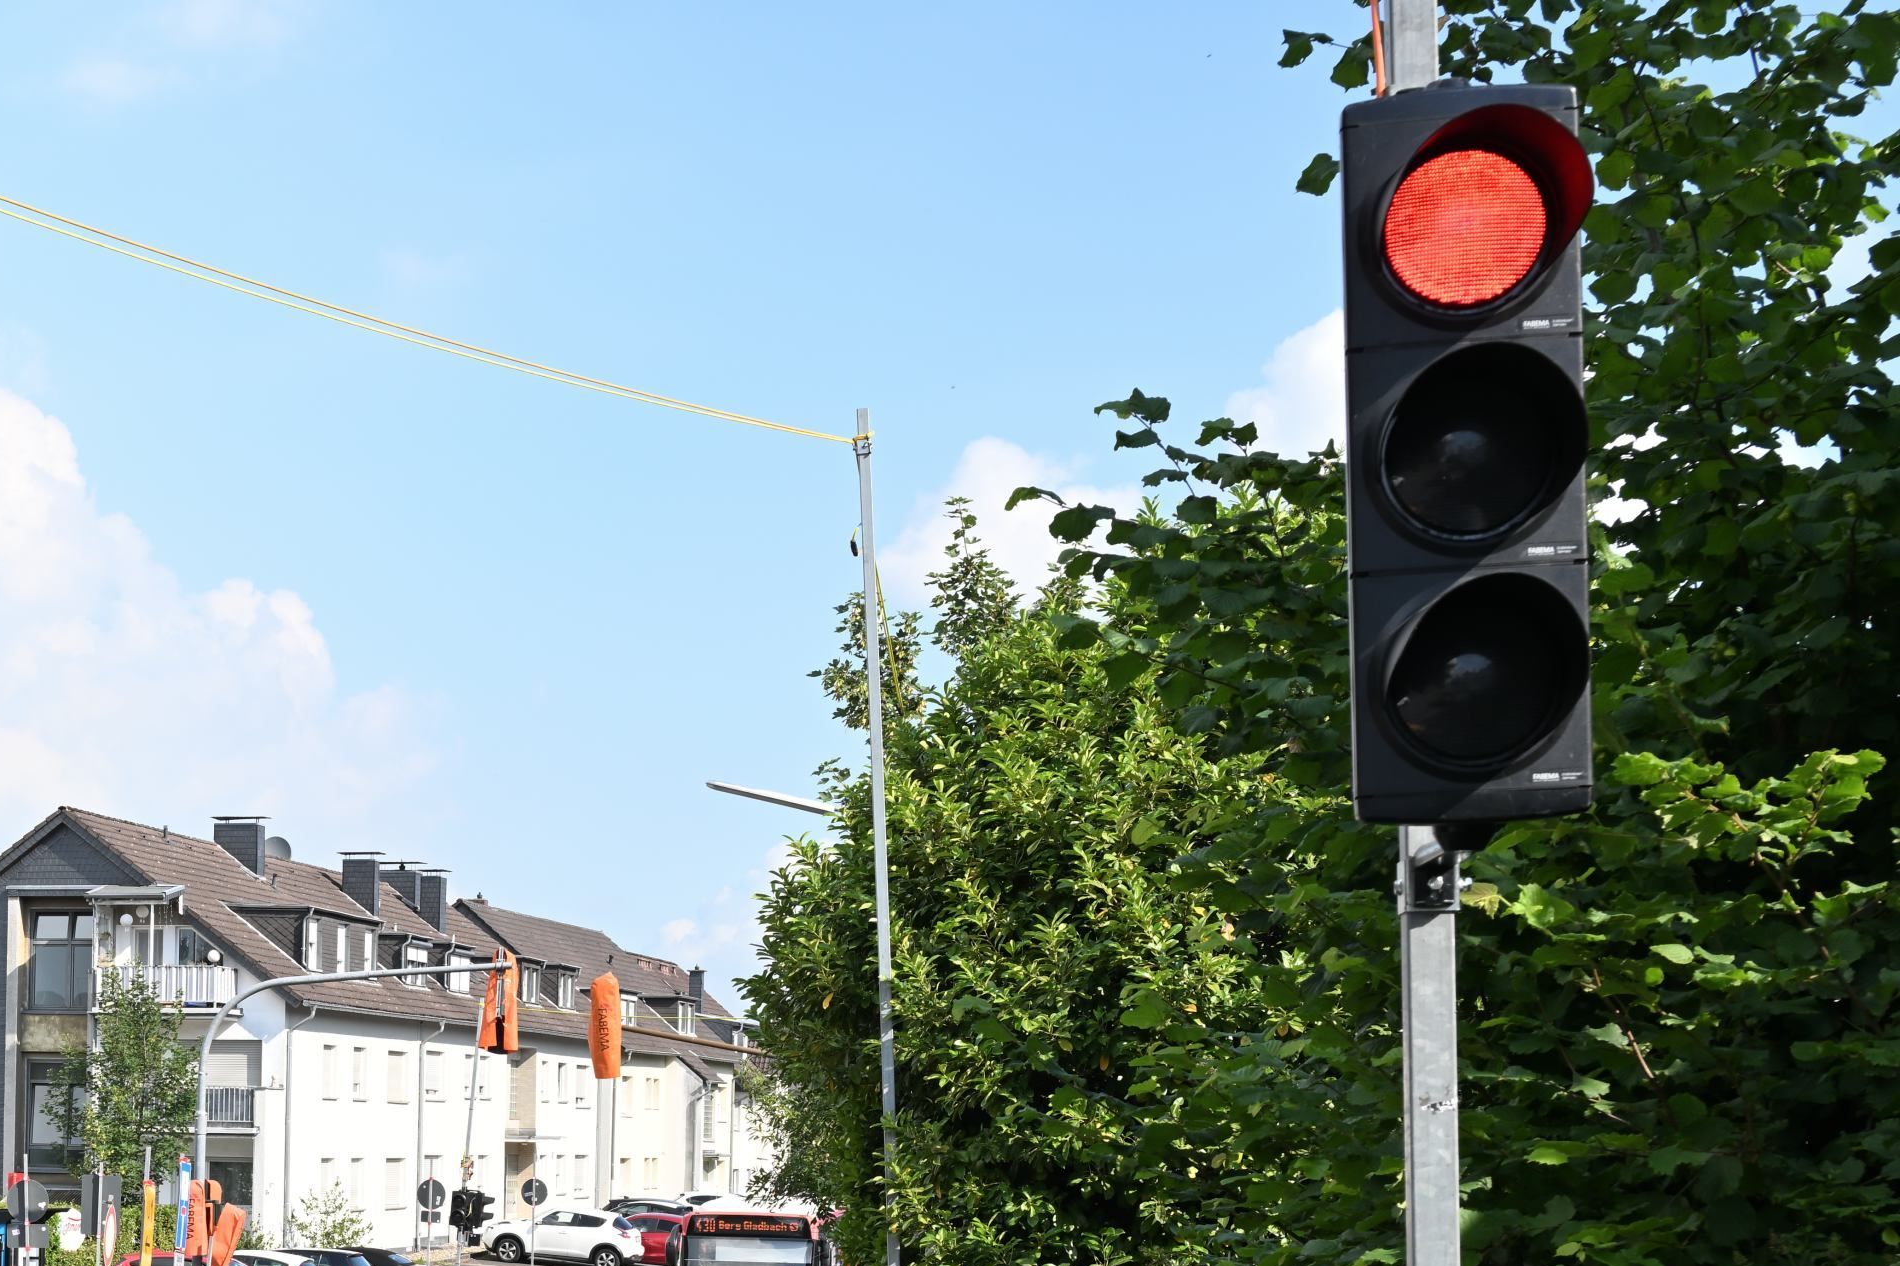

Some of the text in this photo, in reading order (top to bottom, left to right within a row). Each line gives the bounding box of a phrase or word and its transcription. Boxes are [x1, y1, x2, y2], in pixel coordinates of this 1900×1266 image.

[598, 1008, 610, 1051] FABEMA
[718, 1220, 741, 1231] Berg
[743, 1220, 787, 1232] Gladbach
